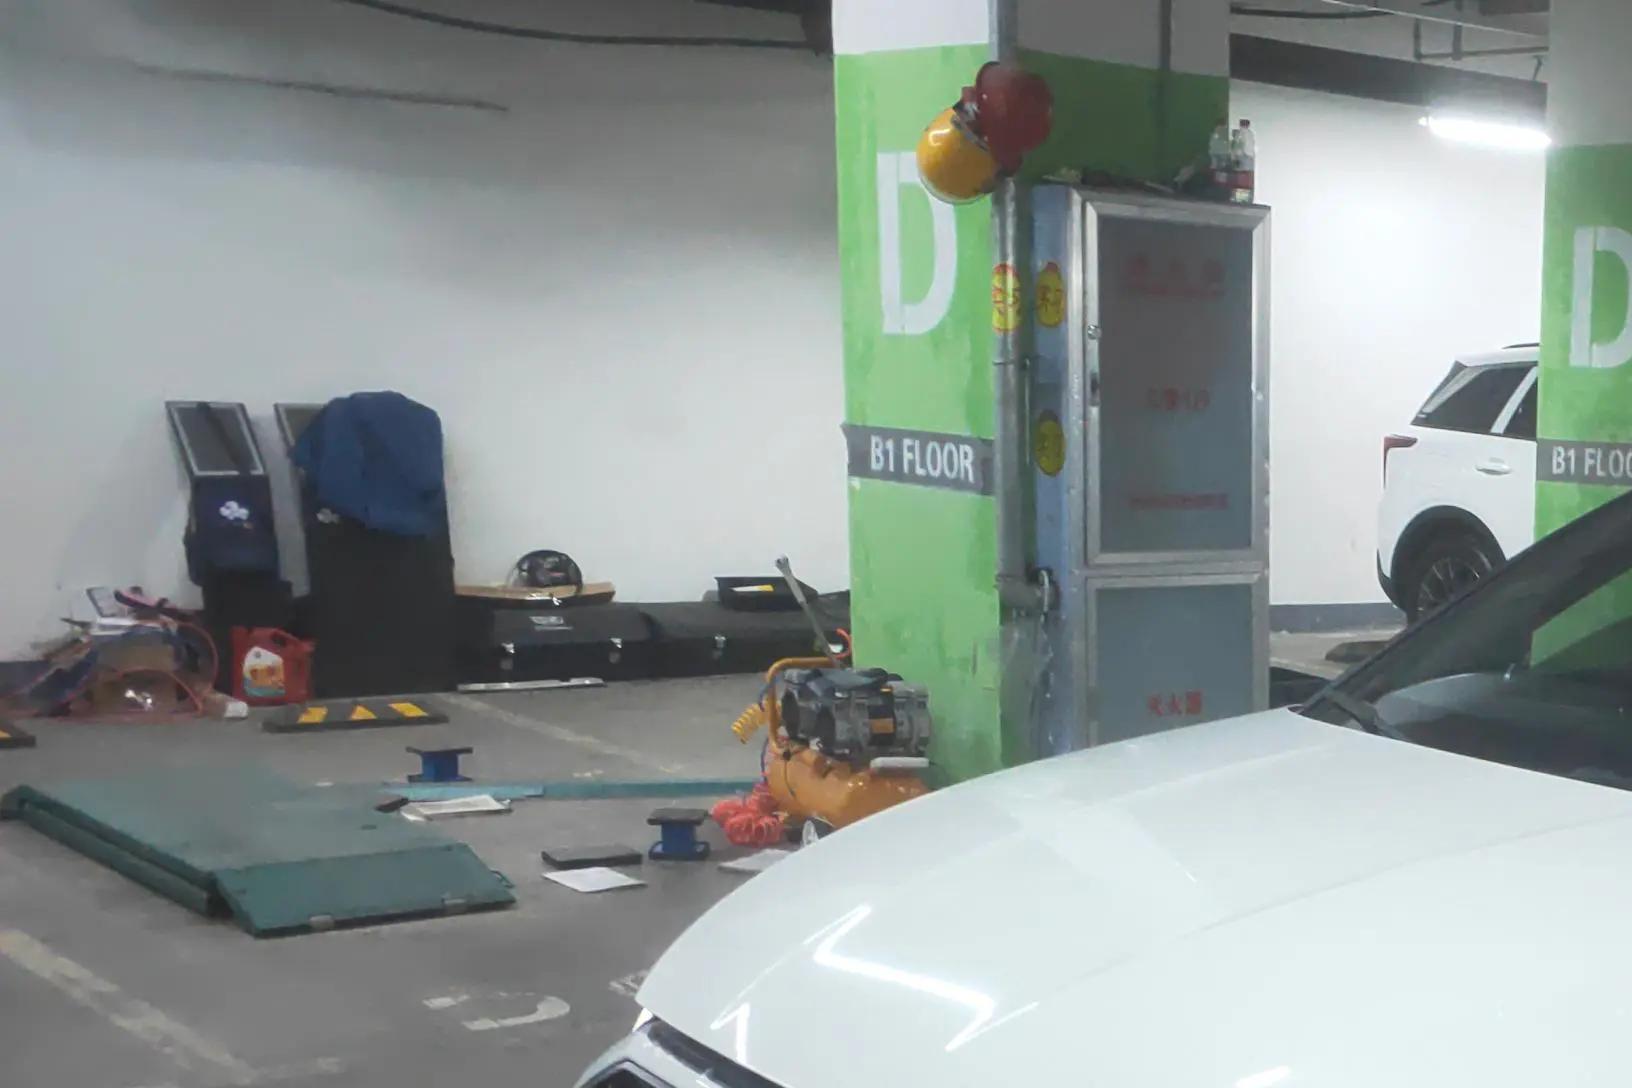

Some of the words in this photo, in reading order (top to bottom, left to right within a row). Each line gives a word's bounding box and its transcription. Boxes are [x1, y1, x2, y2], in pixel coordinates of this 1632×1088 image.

[876, 151, 958, 335] D
[870, 434, 895, 473] B1
[902, 437, 975, 484] FLOOR
[1551, 446, 1576, 476] B1
